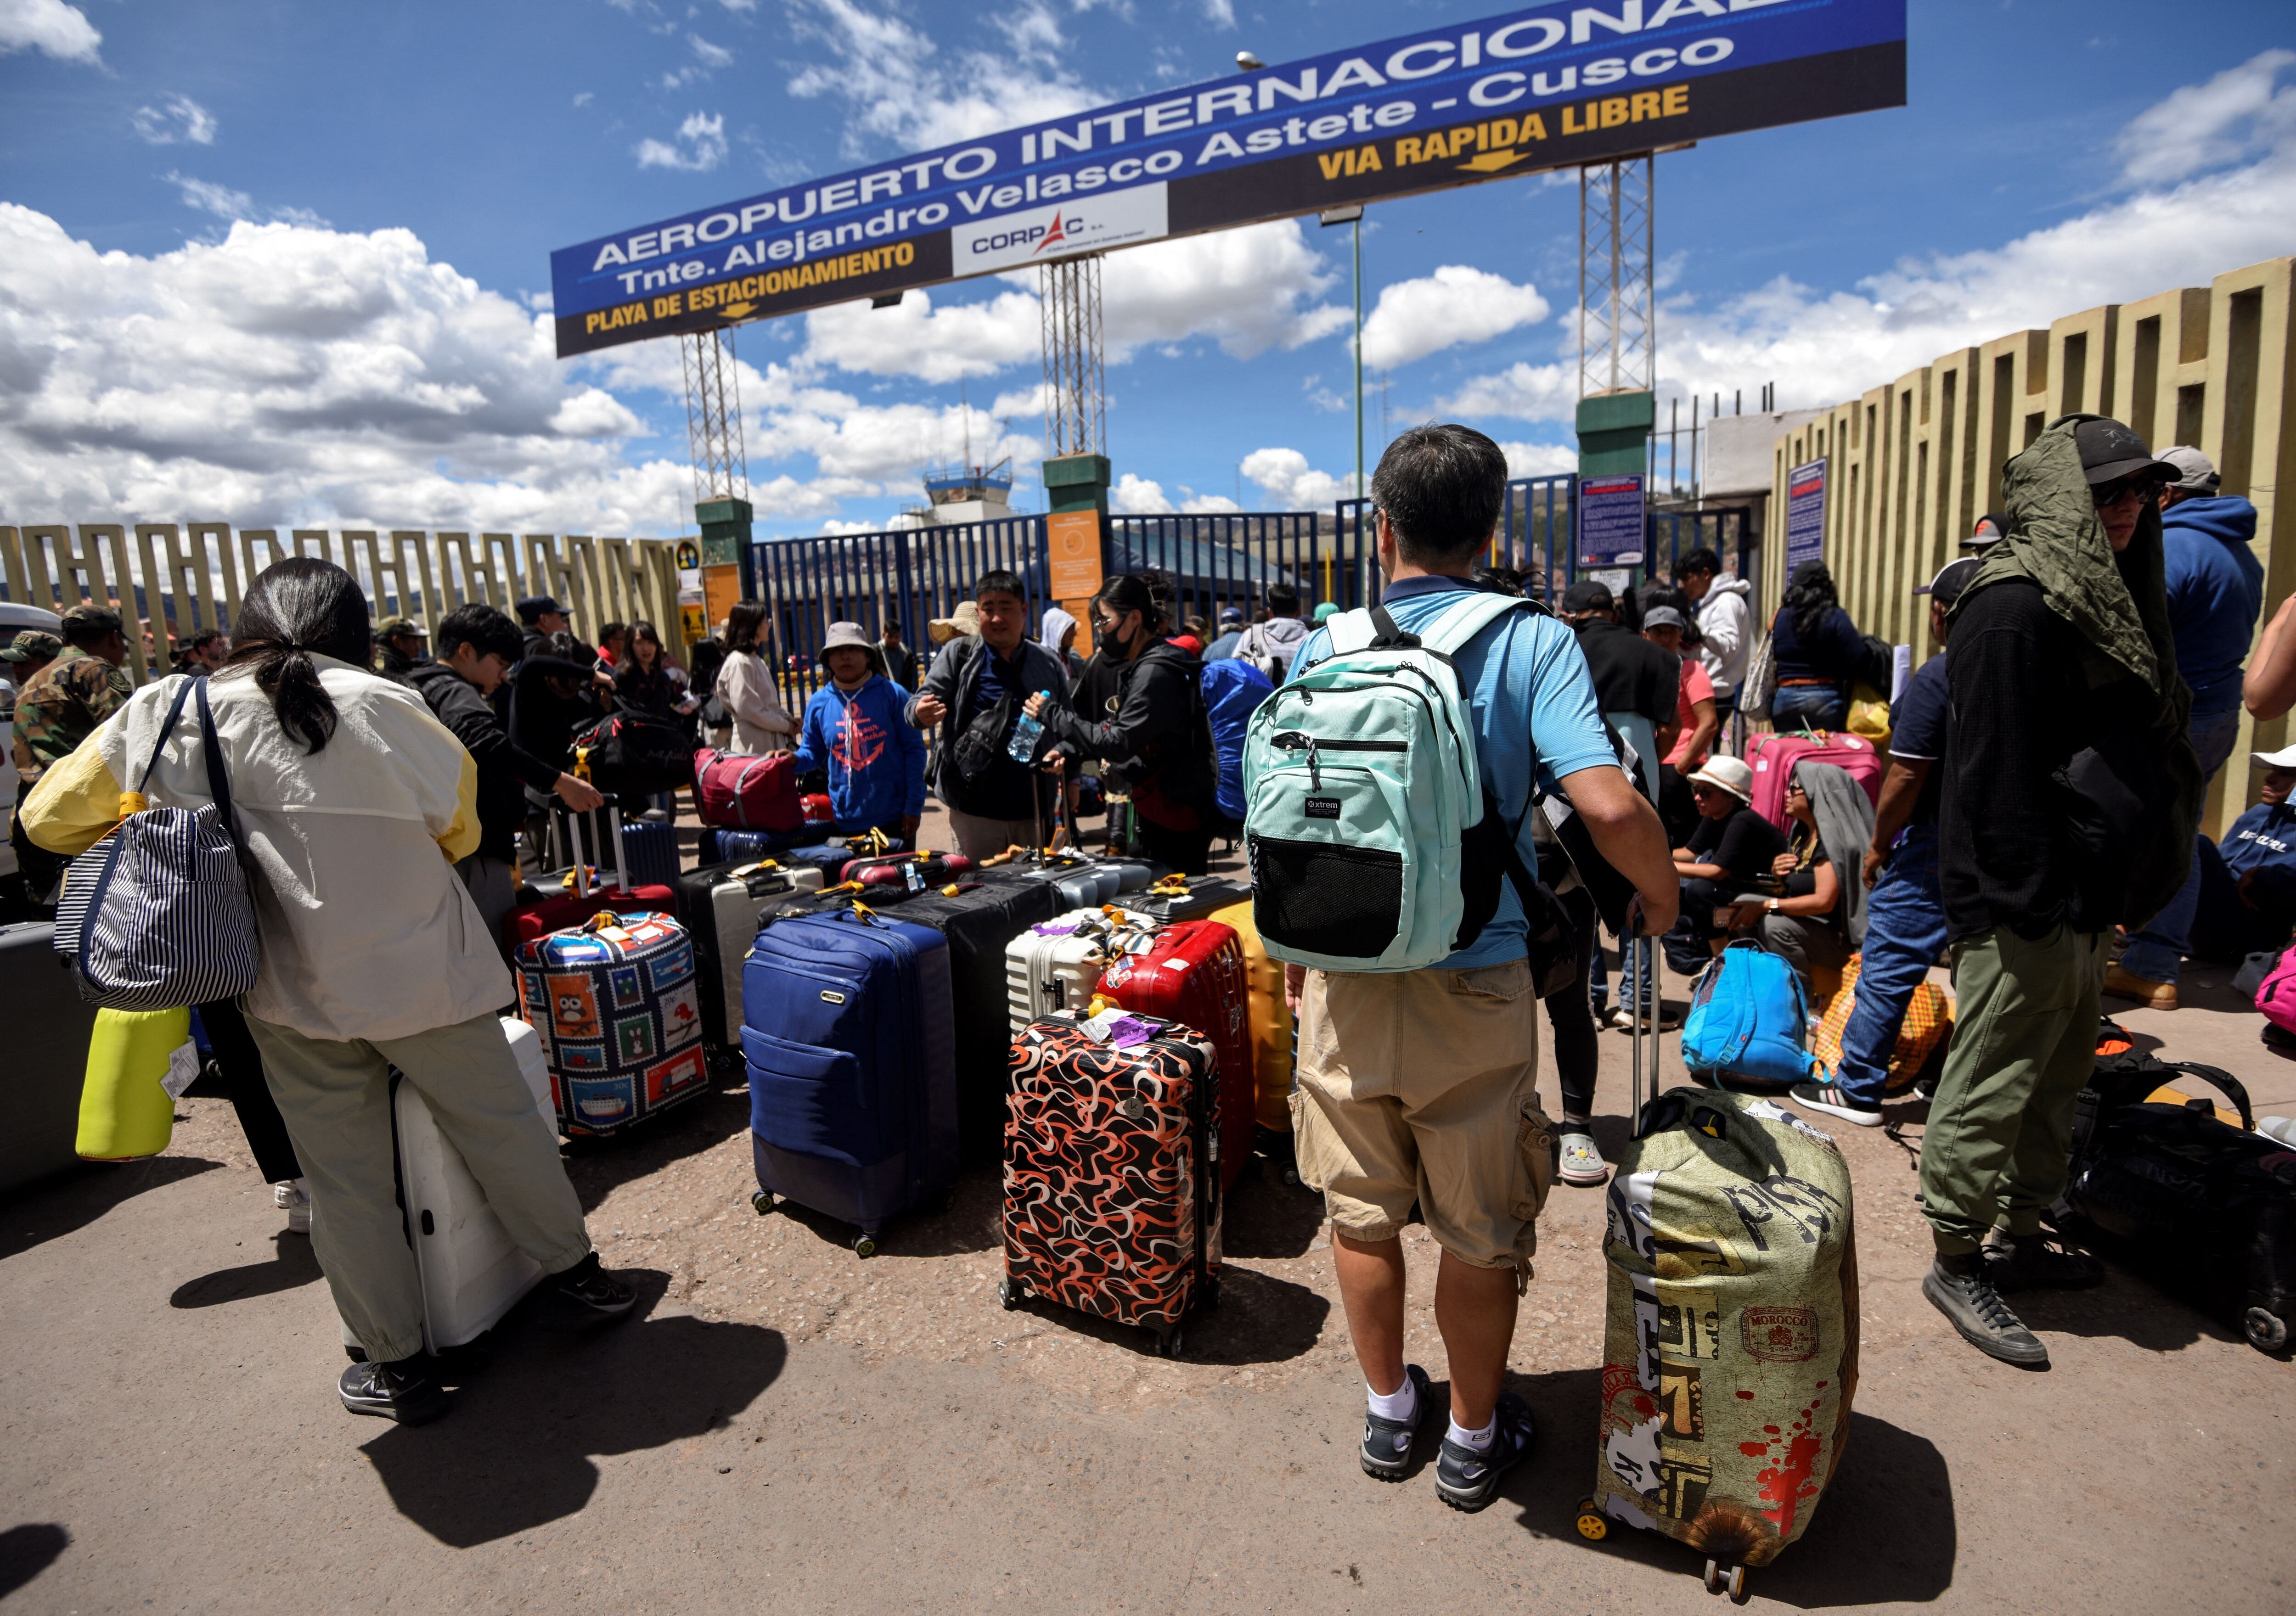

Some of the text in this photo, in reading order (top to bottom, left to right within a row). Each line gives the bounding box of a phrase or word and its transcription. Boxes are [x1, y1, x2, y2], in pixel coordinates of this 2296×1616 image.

[593, 0, 1788, 272] AEROPUERTO INTERNACIONA
[618, 261, 716, 294] Tnte.
[723, 203, 950, 271] Alejandro
[957, 150, 1184, 224] Velasco
[1196, 101, 1417, 165] Astete
[1468, 38, 1735, 107] Cusco
[1318, 85, 1689, 180] VIA RAPIDA LIBRE
[972, 209, 1084, 255] CORPAC
[586, 242, 914, 333] PLAYA DE ESTACIONAMIENTO
[1586, 483, 1637, 495] COMUNICADO
[613, 1082, 629, 1091] 30c
[1750, 1315, 1808, 1327] MOROCCO
